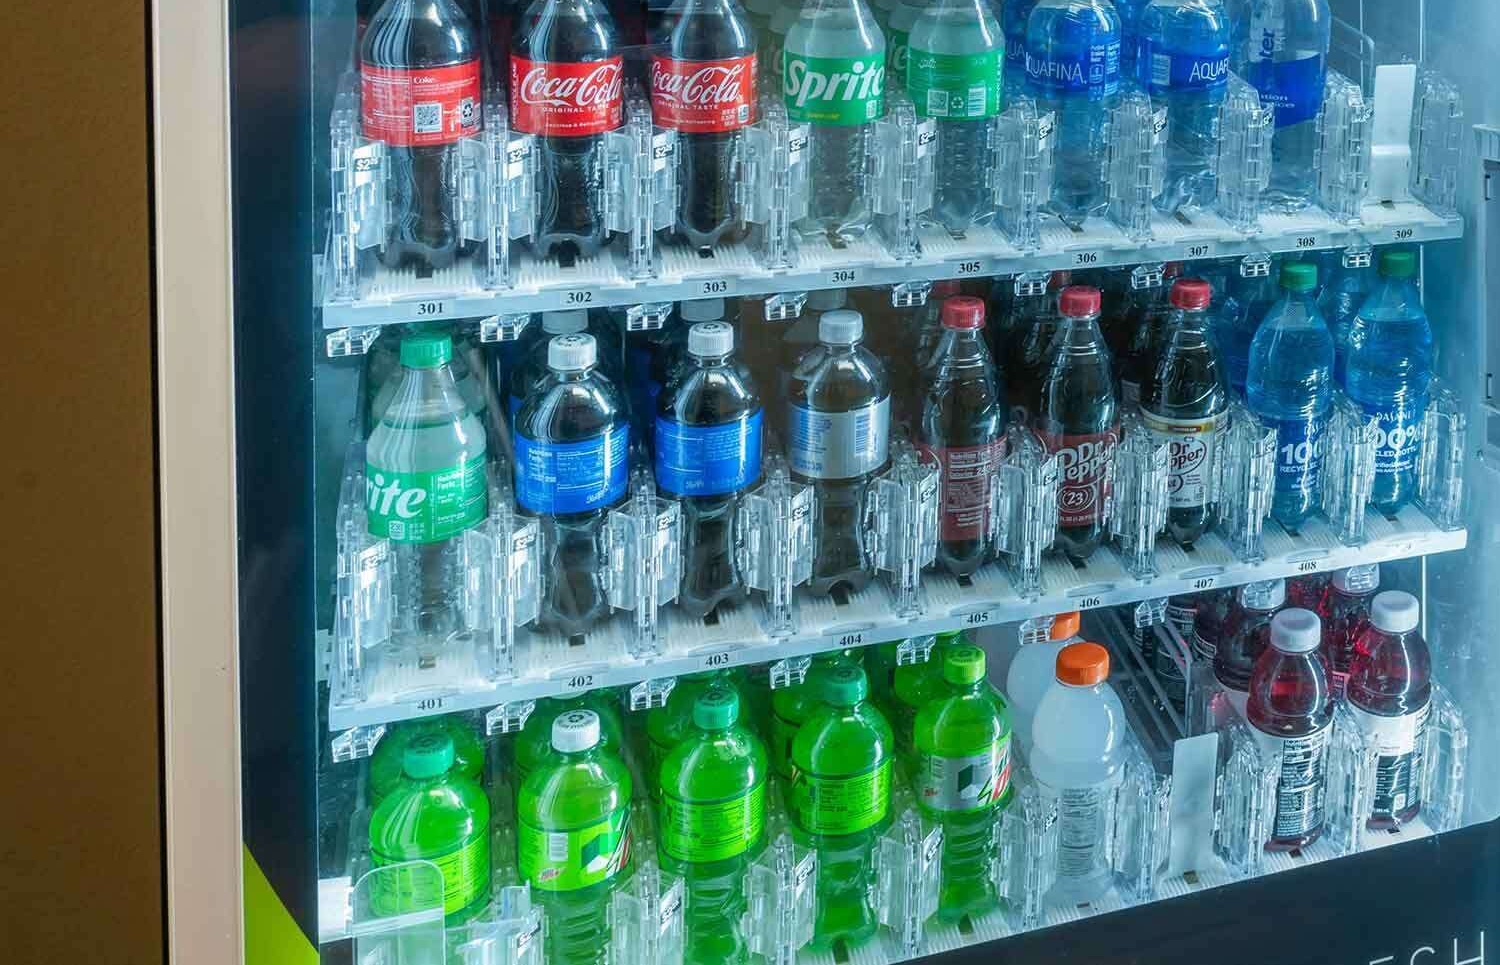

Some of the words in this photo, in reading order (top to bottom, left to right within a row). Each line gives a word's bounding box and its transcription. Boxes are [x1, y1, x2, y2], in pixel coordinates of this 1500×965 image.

[413, 76, 435, 85] Coke
[519, 63, 623, 108] Coca-Cola
[785, 59, 885, 108] Sprite
[542, 106, 585, 114] ORIGINAL
[1393, 227, 1415, 241] 309
[1295, 235, 1317, 249] 308
[1075, 251, 1098, 265] 306
[1188, 245, 1209, 259] 307
[958, 261, 982, 275] 305
[830, 269, 857, 284] 304
[702, 280, 728, 294] 303
[565, 290, 593, 305] 302
[416, 301, 445, 317] 301
[1375, 410, 1413, 423] DASANI
[1077, 441, 1104, 459] Dr
[1169, 442, 1190, 457] Dr
[1055, 447, 1115, 483] Pepper
[1066, 491, 1083, 505] 23
[1297, 559, 1318, 573] 408
[1193, 577, 1215, 591] 407
[1078, 595, 1101, 609] 406
[966, 611, 990, 625] 405
[838, 632, 863, 647] 404
[705, 652, 730, 667] 403
[568, 674, 594, 689] 402
[416, 696, 444, 712] 401
